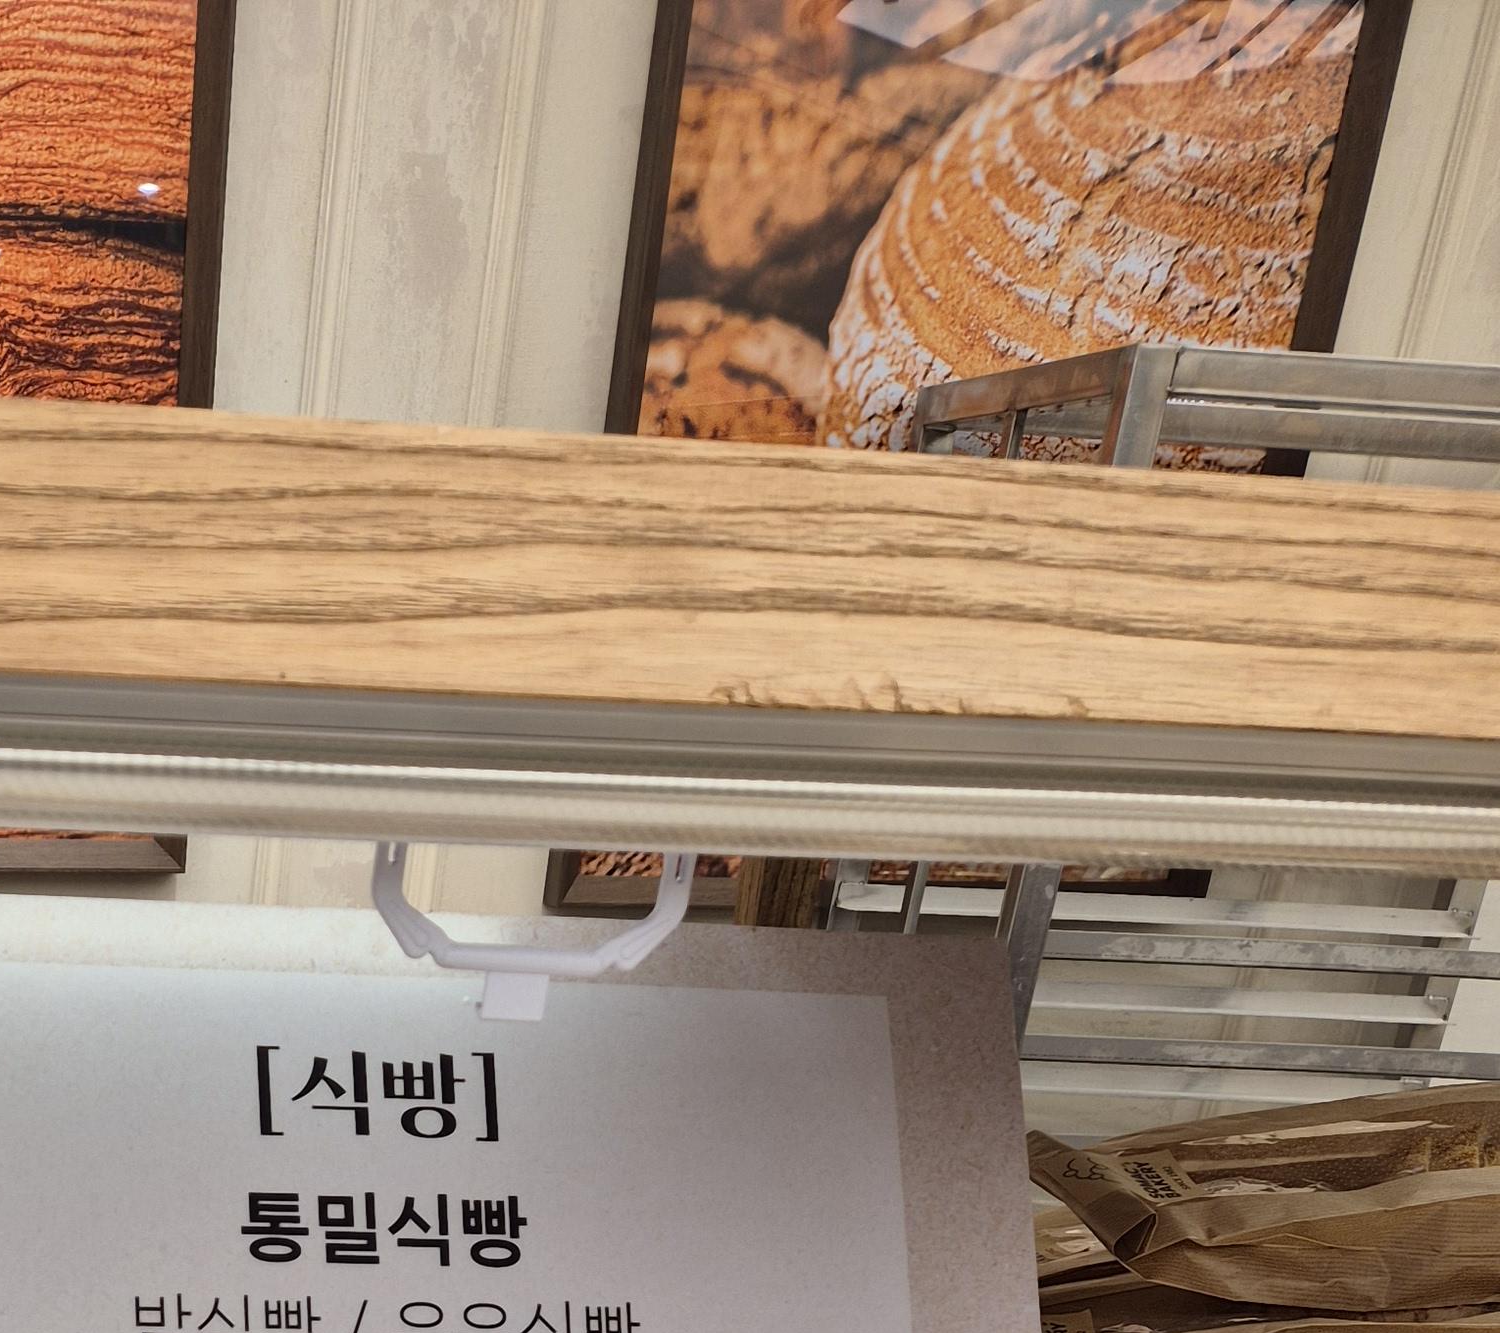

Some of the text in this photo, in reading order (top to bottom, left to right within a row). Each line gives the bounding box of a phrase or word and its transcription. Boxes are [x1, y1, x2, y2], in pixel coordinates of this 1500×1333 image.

[256, 1045, 500, 1142] [식빵]
[1124, 1166, 1163, 1199] SOMAC
[1133, 1161, 1182, 1199] BAKERY
[241, 1191, 528, 1268] 통밀식빵
